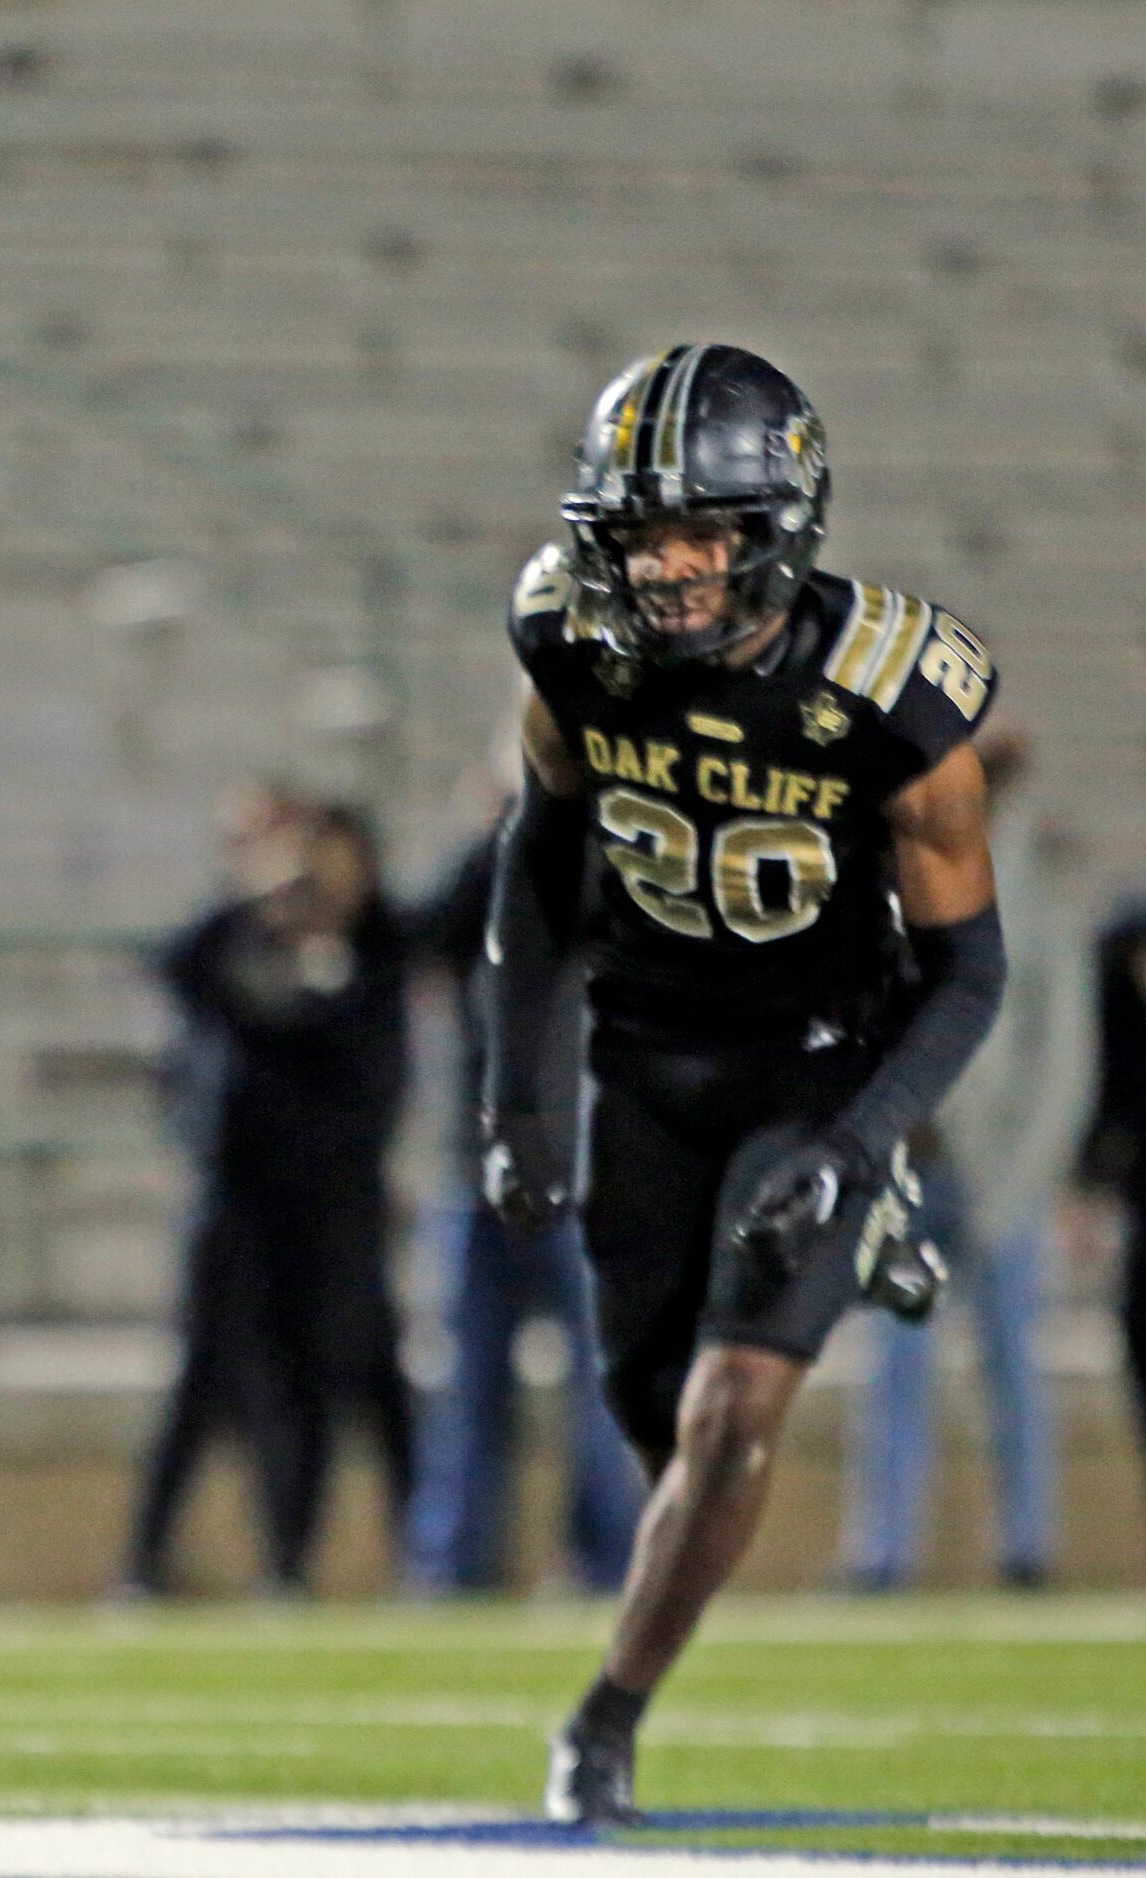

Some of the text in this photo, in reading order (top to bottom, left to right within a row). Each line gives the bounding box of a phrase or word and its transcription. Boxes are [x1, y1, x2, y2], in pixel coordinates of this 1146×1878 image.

[918, 610, 991, 722] 20
[584, 727, 850, 819] OAK CLIFF
[599, 787, 837, 943] 20
